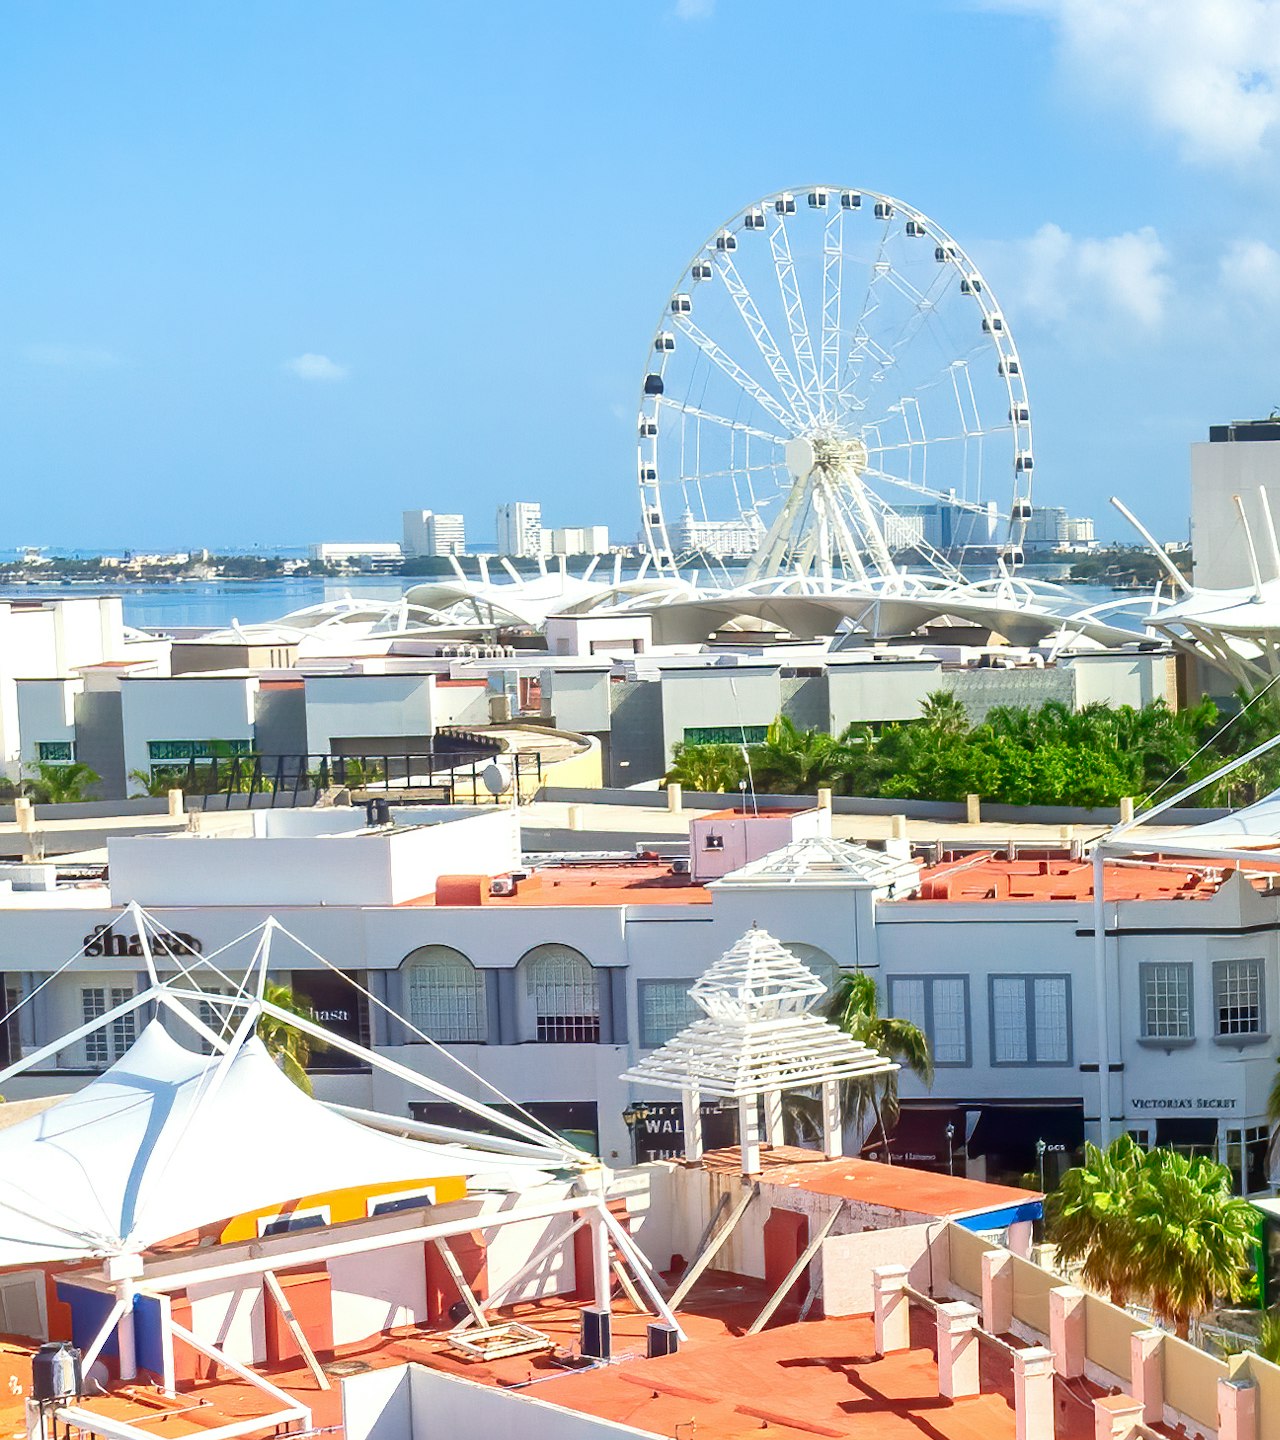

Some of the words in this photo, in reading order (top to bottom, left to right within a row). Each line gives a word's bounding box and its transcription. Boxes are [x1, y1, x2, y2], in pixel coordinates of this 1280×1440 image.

[83, 924, 202, 957] shasa
[308, 1006, 350, 1021] hasa
[1196, 1097, 1237, 1108] SECRET
[645, 1119, 684, 1134] WAL
